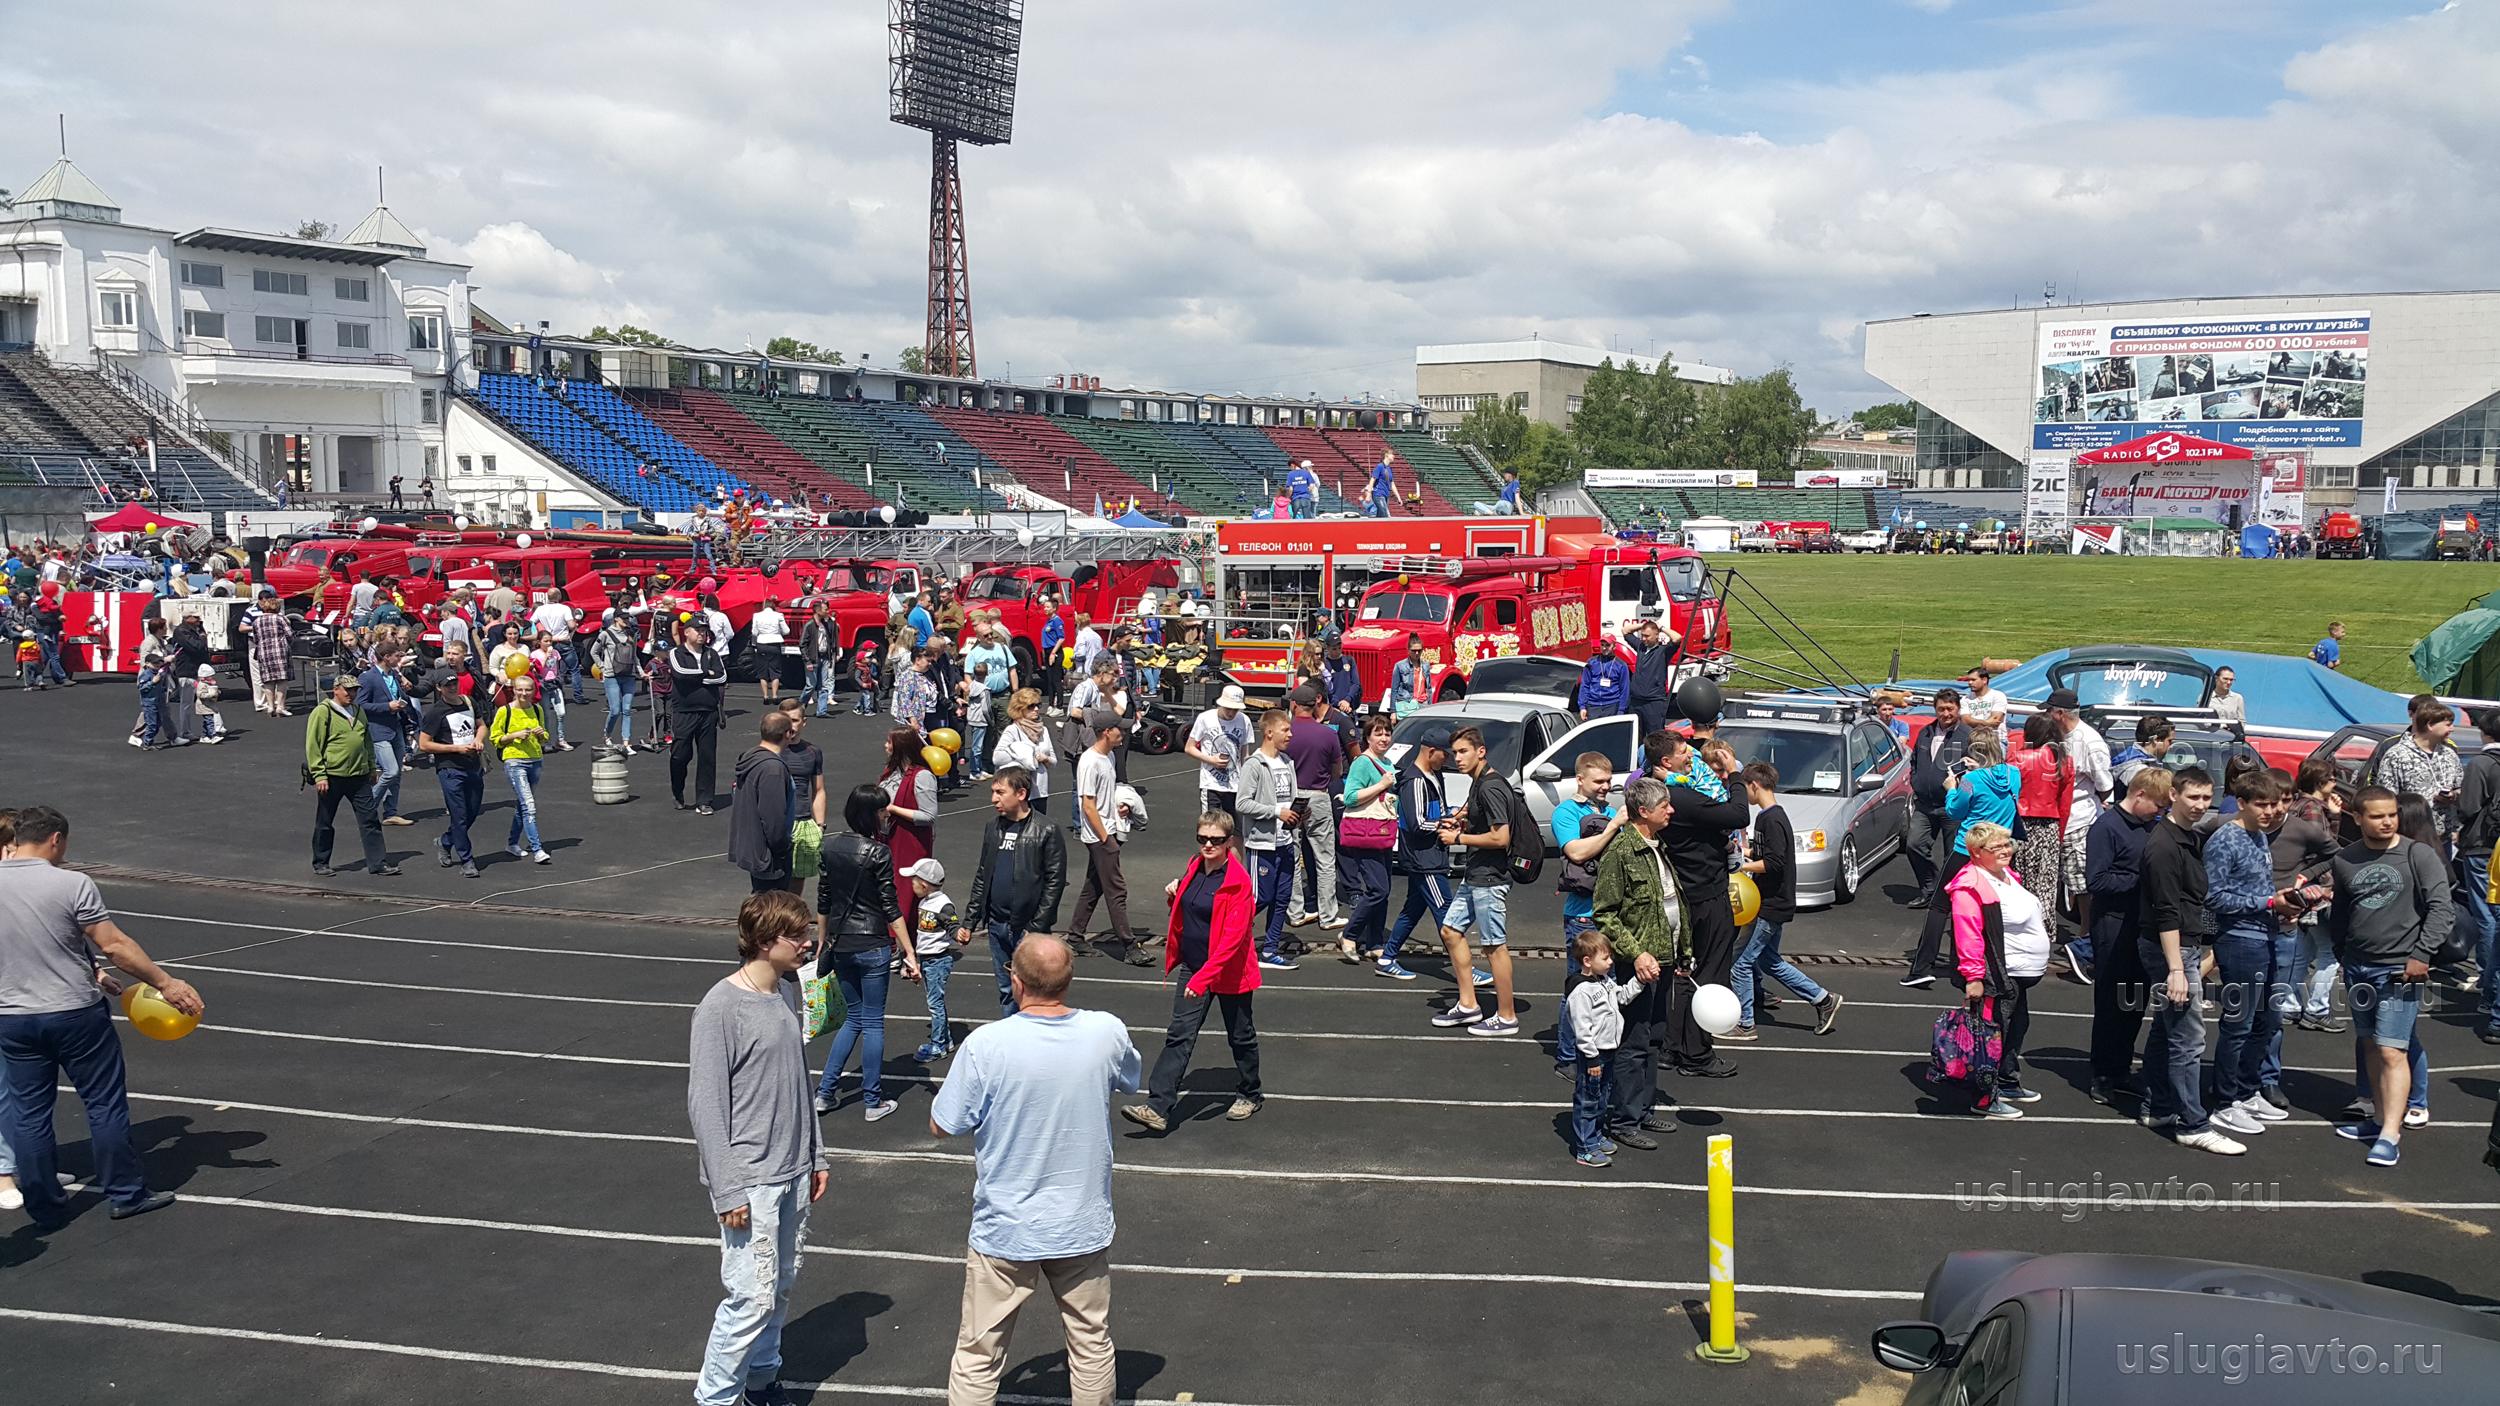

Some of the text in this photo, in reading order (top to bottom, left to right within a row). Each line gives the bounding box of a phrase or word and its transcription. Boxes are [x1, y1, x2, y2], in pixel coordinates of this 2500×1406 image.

[2116, 327, 2180, 336] ОБЪЯВЛЯЮТ
[2182, 324, 2262, 334] ФОТОКОНКУРС
[2280, 322, 2312, 331] КРУГУ
[2314, 318, 2364, 330] ДРУЗЕЙ»
[2125, 342, 2188, 352] ПРИЗОВЫМ
[2190, 340, 2242, 350] ФОНДОМ
[2244, 338, 2276, 349] 600
[2280, 337, 2312, 348] 000
[2315, 337, 2357, 347] рублей
[2239, 426, 2298, 435] Подробности
[2232, 435, 2346, 444] www.discovery-market.ru
[2103, 450, 2141, 459] RADIO
[2186, 449, 2206, 457] 102.1
[2030, 478, 2066, 492] ZIC
[2101, 484, 2249, 498] БАЙАЛ МОТОР ШОУ
[240, 515, 248, 527] 5
[1238, 543, 1282, 551] ТЕЛЕФОН
[1482, 648, 1488, 659] 1
